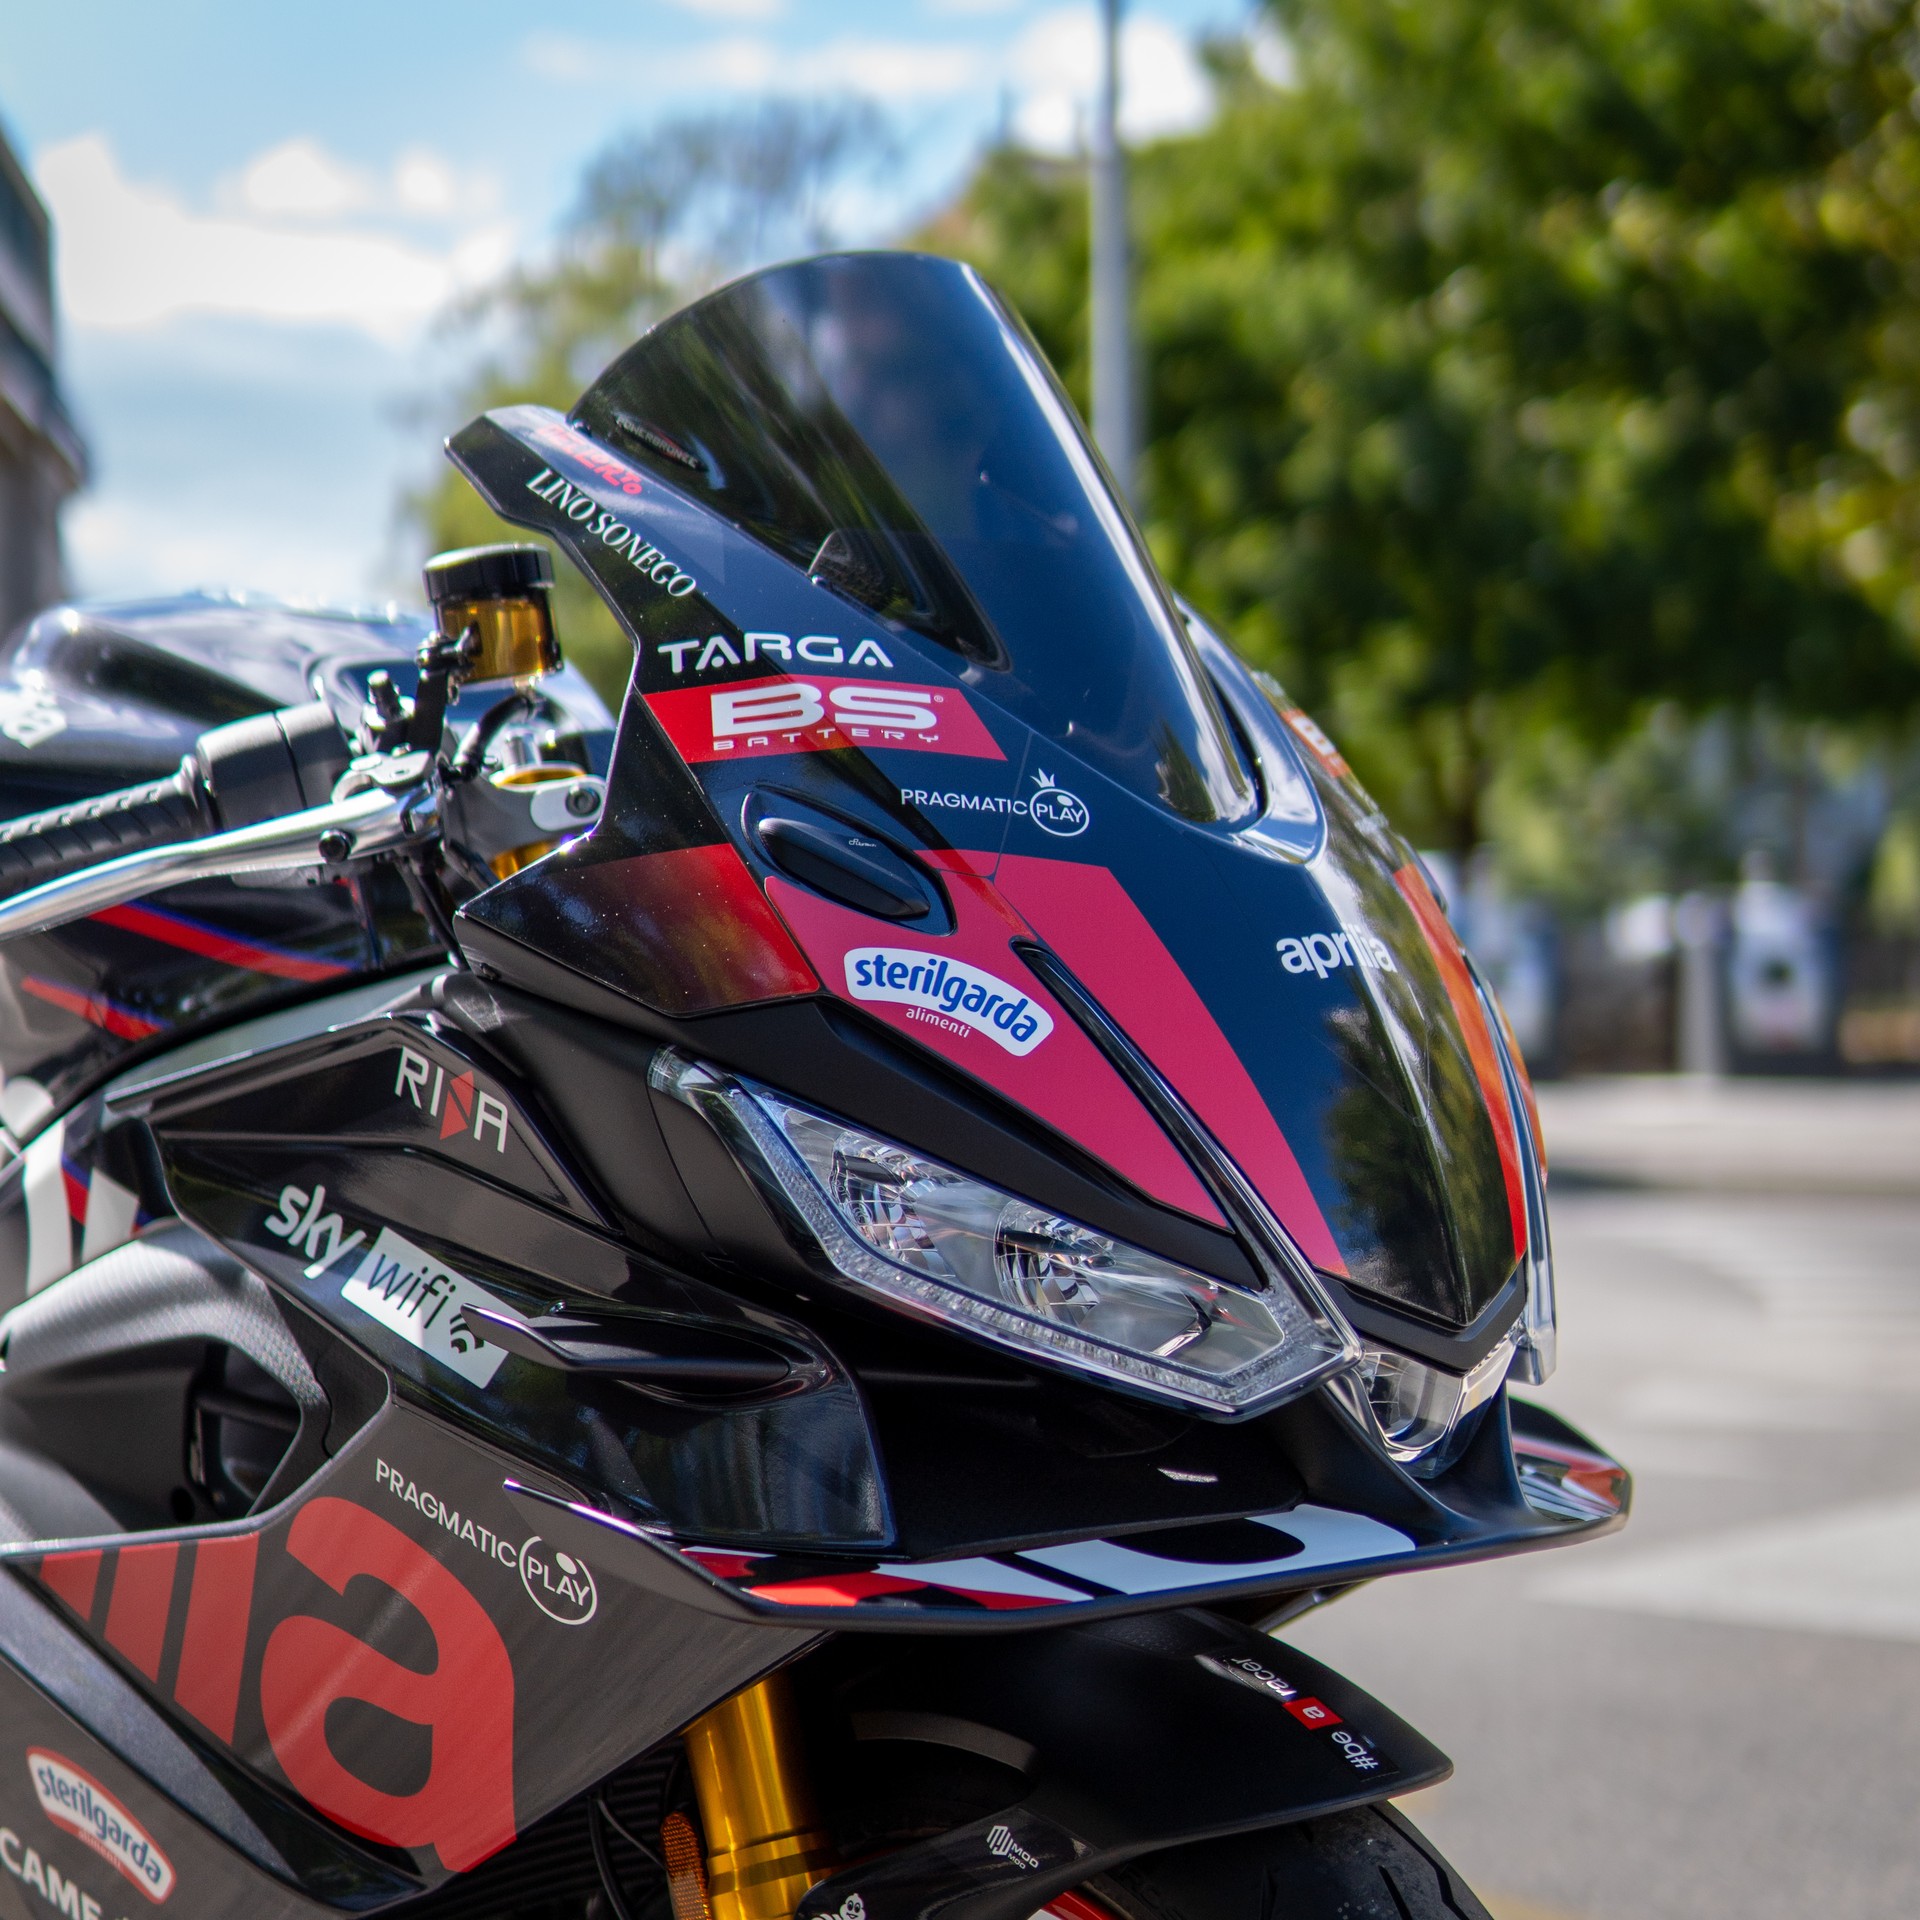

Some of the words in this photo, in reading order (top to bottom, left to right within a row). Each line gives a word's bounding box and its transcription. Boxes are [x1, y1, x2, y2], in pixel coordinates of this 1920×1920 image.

[525, 467, 597, 521] LINO
[585, 512, 697, 597] SONEGO
[657, 632, 894, 674] TARGA
[713, 727, 940, 751] BATTERY
[901, 788, 1029, 816] PRAGMATIC
[1036, 803, 1084, 825] PLAY
[1276, 922, 1398, 980] aprilia
[855, 954, 1039, 1043] sterilgarda
[905, 1006, 972, 1039] alimenti
[394, 1045, 509, 1154] RINA
[264, 1183, 368, 1281] sky
[367, 1253, 457, 1330] wifi
[375, 1457, 518, 1568] PRAGMATIC
[527, 1555, 591, 1607] PLAY
[1230, 1658, 1298, 1697] racer
[1302, 1706, 1326, 1719] a
[1331, 1731, 1379, 1770] #be
[37, 1765, 163, 1885] sterilgarda
